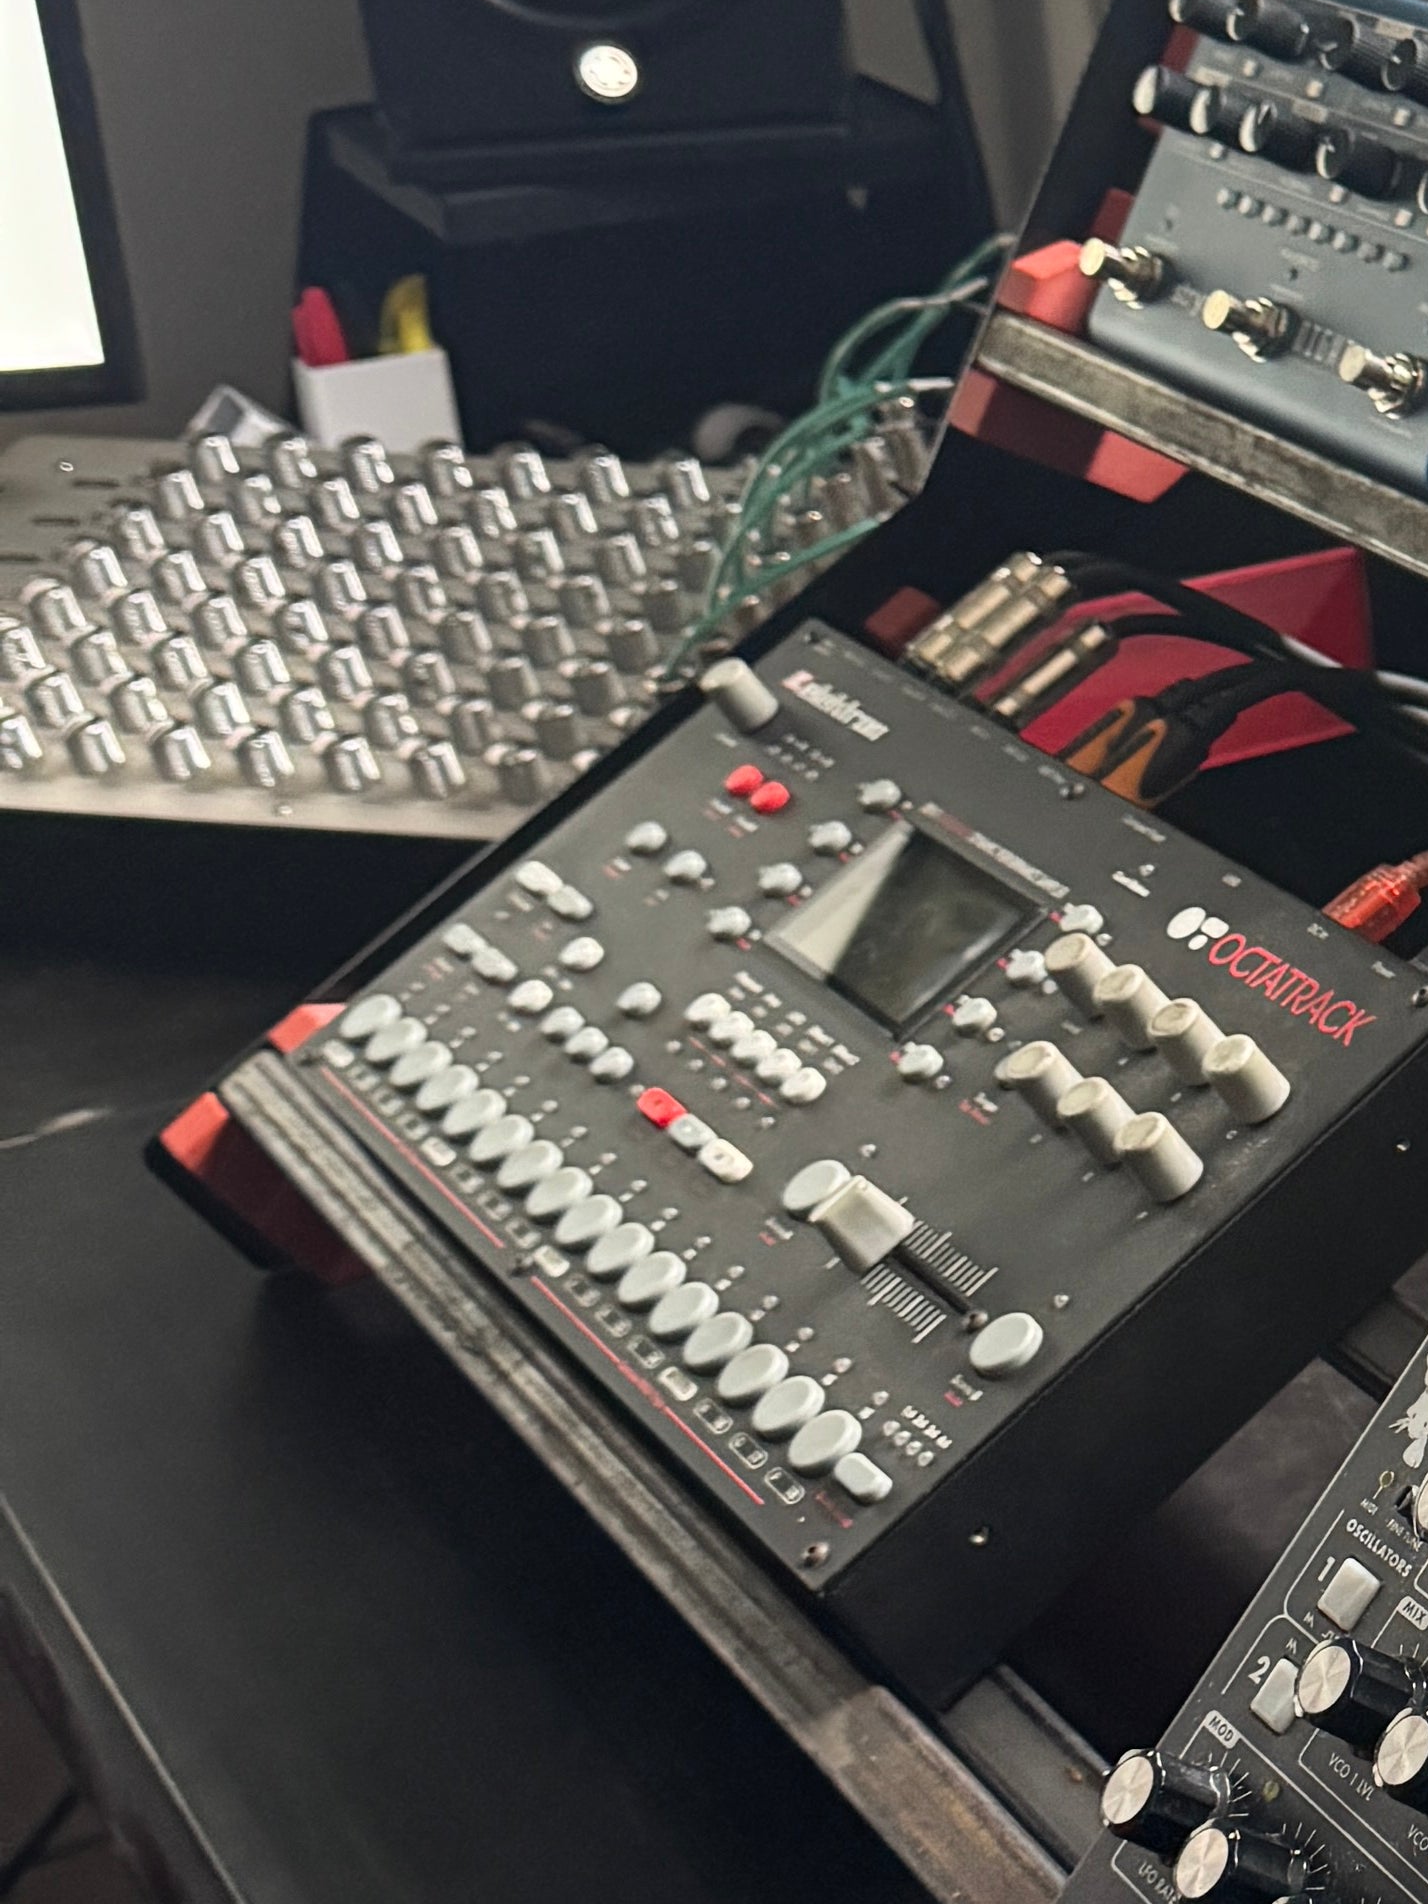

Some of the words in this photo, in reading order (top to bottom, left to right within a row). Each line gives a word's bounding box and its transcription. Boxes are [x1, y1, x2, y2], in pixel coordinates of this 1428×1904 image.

[1208, 933, 1377, 1047] OCTATRACK
[1346, 1518, 1413, 1578] OSCILLATORS
[1318, 1556, 1336, 1582] 1
[1403, 1601, 1428, 1624] MIX
[1248, 1655, 1271, 1685] 2
[1208, 1716, 1235, 1742] MOD
[1329, 1752, 1351, 1779] VCO
[1356, 1781, 1375, 1802] LVL
